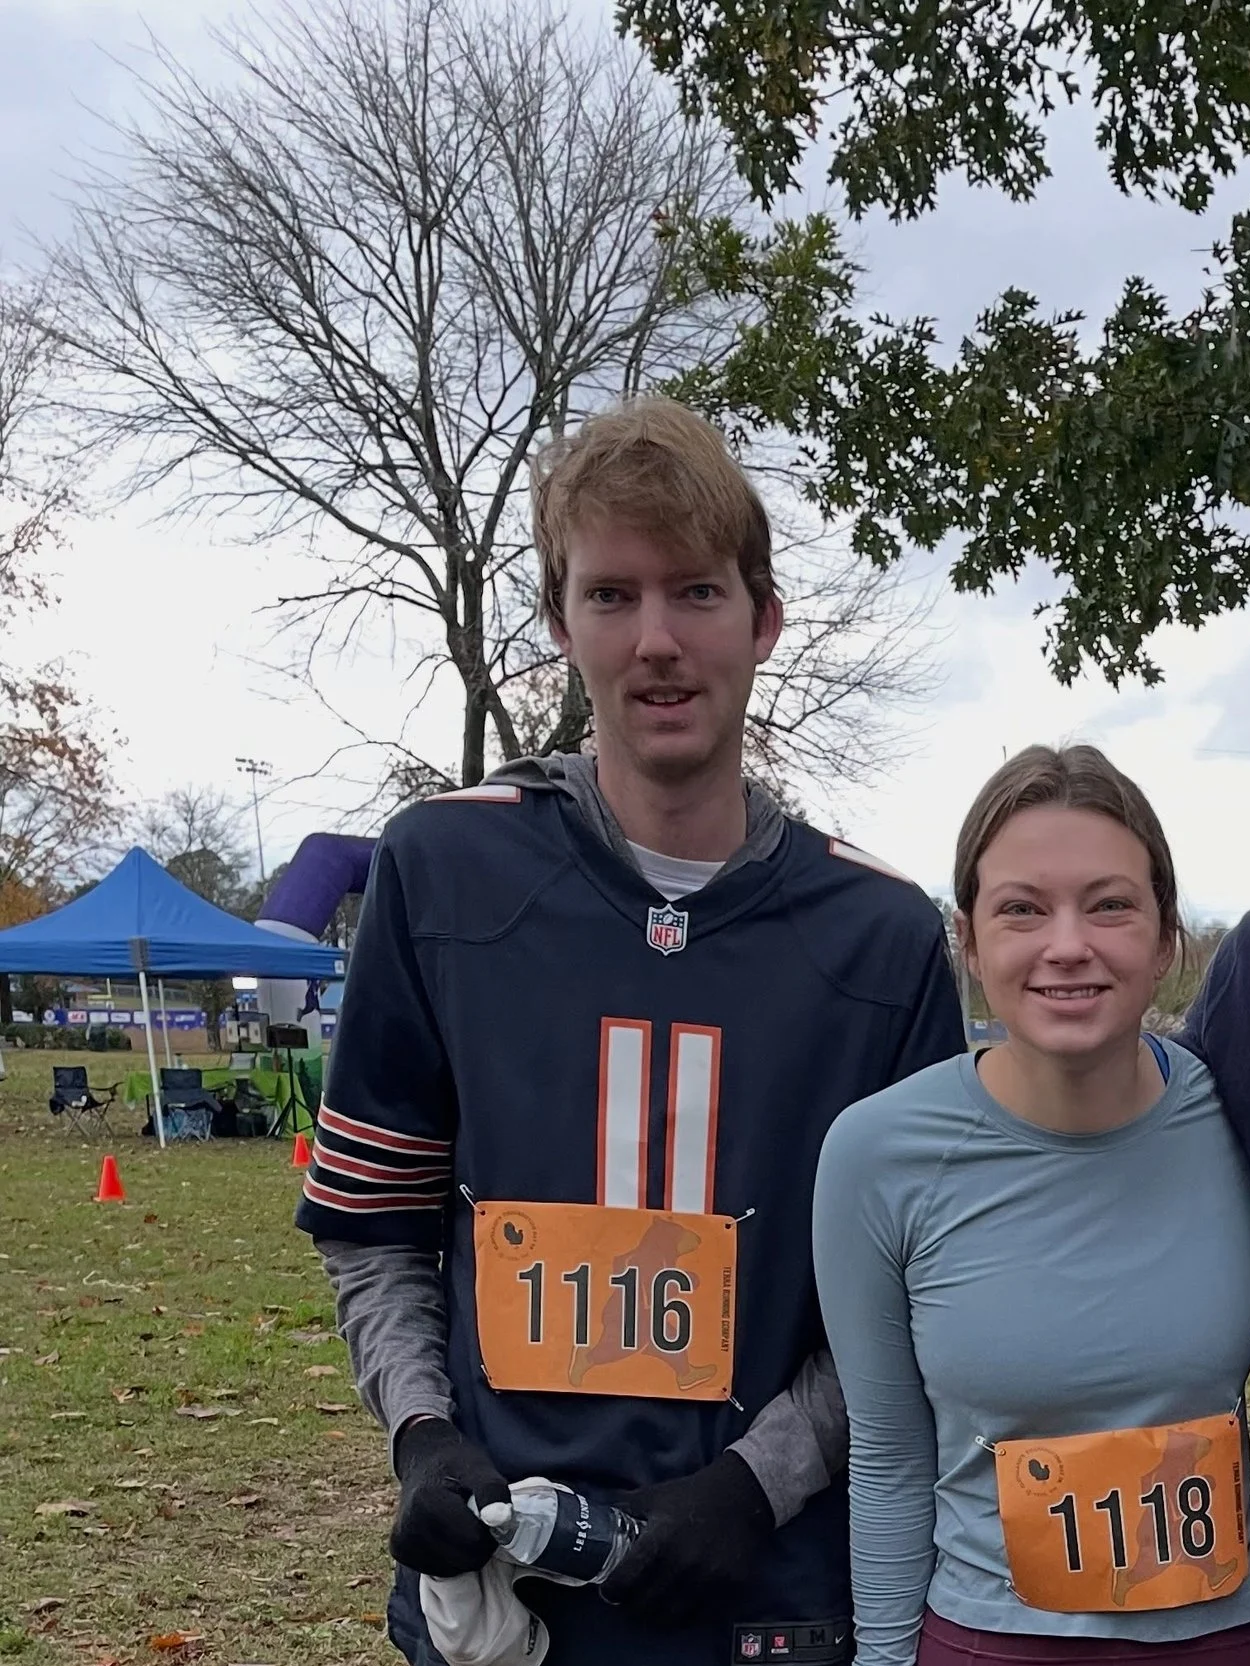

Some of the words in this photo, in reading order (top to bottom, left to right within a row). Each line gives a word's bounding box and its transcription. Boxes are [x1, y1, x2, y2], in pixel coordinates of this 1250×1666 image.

[653, 924, 682, 947] NFL
[597, 1016, 722, 1214] 11
[516, 1260, 693, 1354] 1116
[1048, 1475, 1216, 1573] 1118
